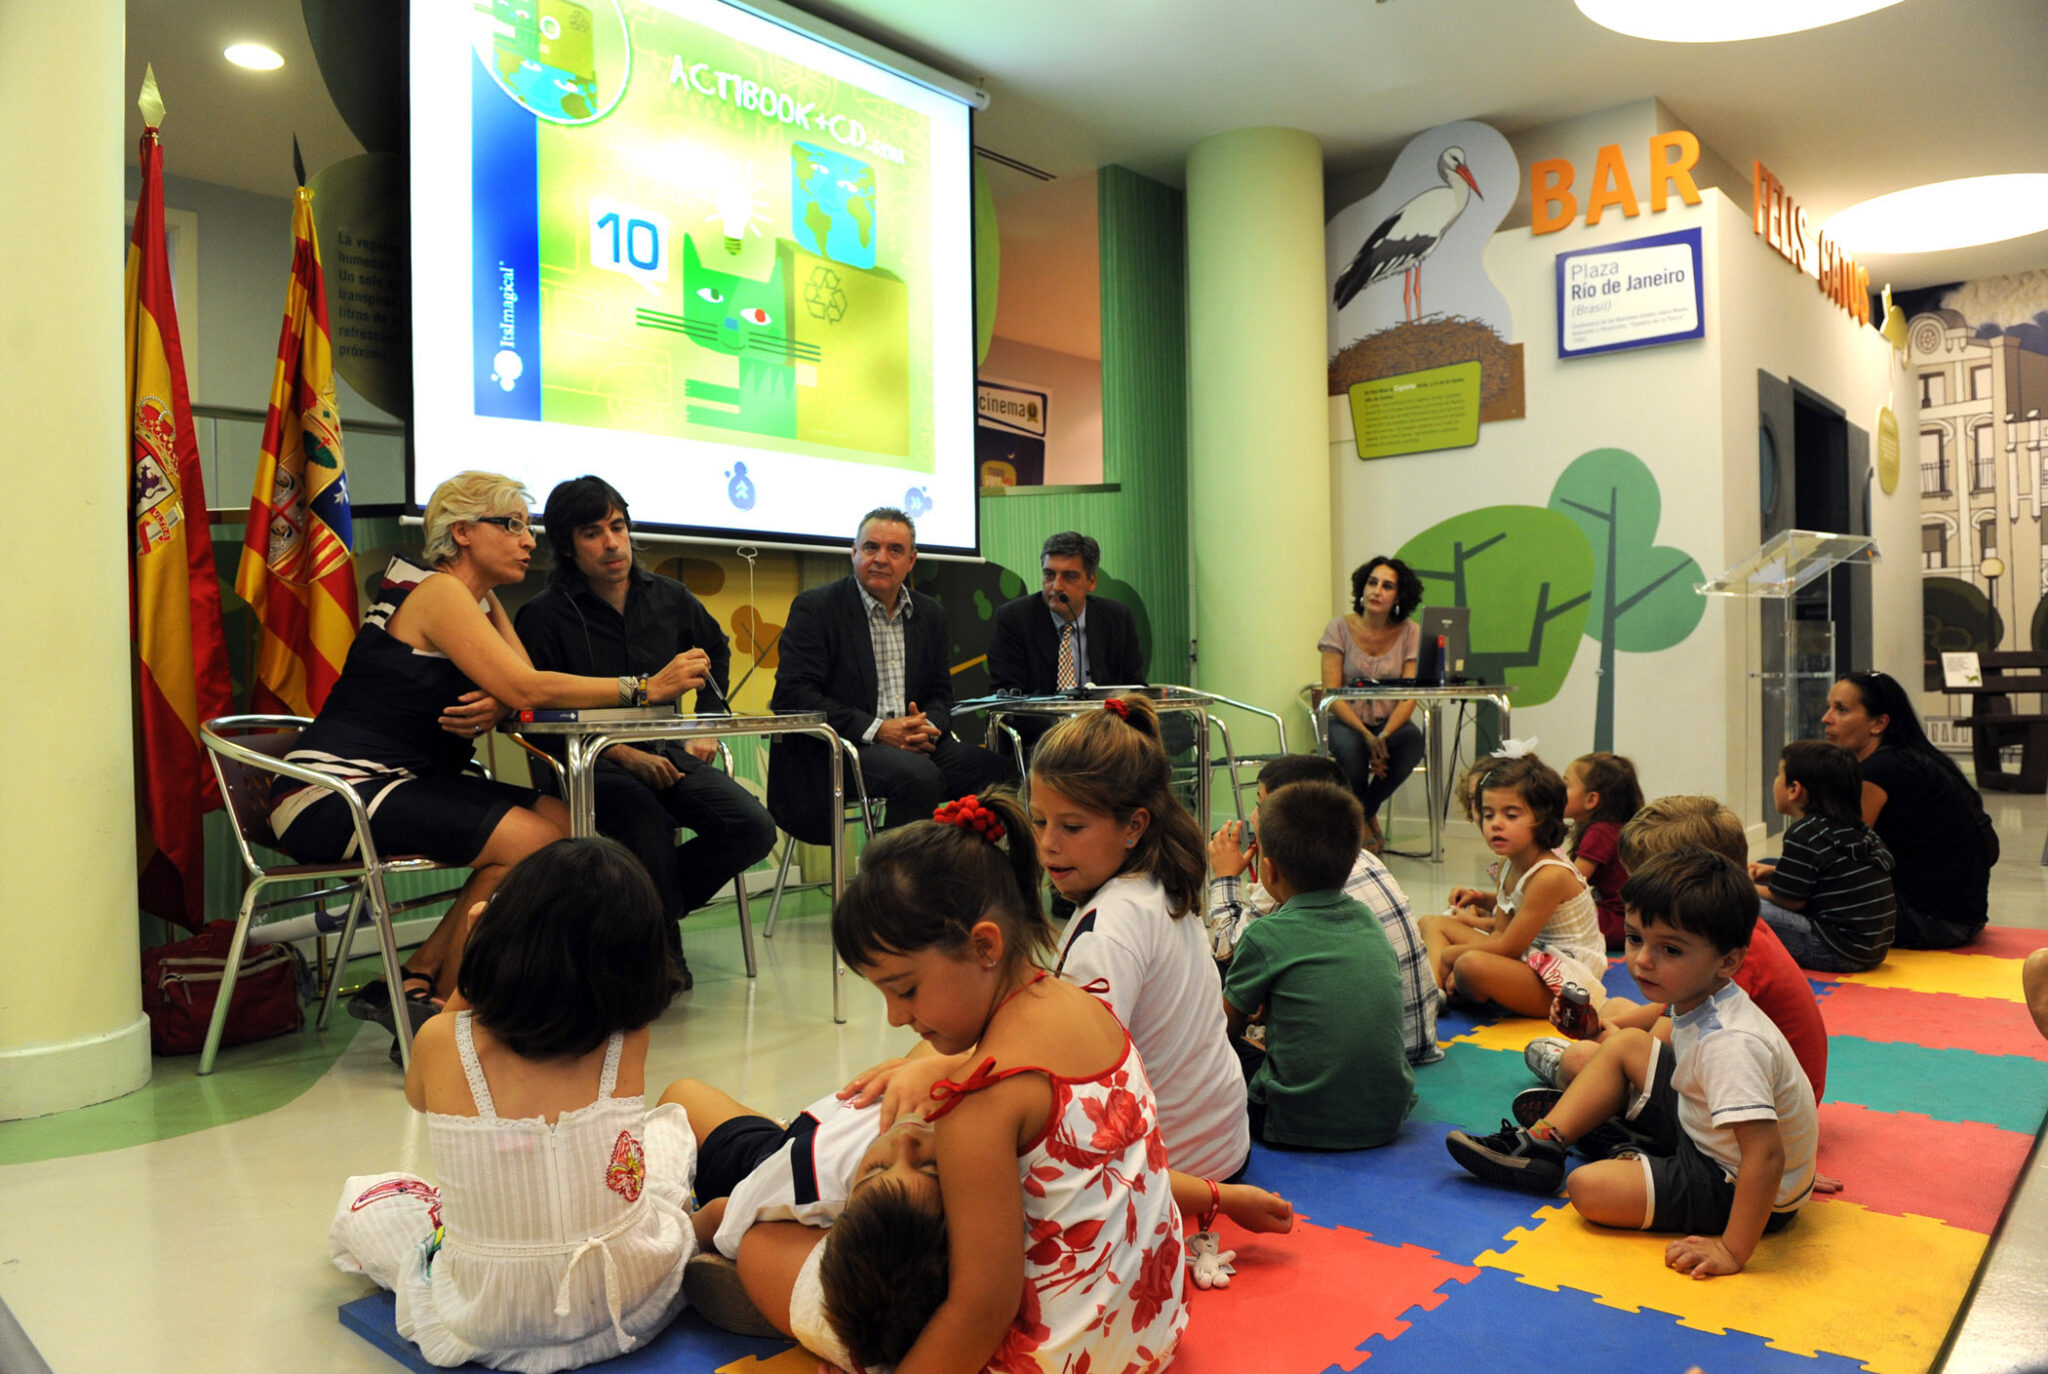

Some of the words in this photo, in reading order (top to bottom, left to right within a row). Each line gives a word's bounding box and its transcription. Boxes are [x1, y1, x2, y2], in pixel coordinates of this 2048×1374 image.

[1530, 129, 1703, 237] BAR
[1753, 159, 1808, 274] FELIS
[338, 231, 352, 246] La
[596, 212, 659, 271] 10
[338, 269, 354, 283] Un
[359, 275, 384, 289] solo
[1571, 260, 1619, 282] Plaza
[1602, 277, 1621, 296] de
[1626, 268, 1685, 292] Janeiro
[1571, 298, 1612, 318] (Brasil)
[978, 392, 1026, 418] cinema
